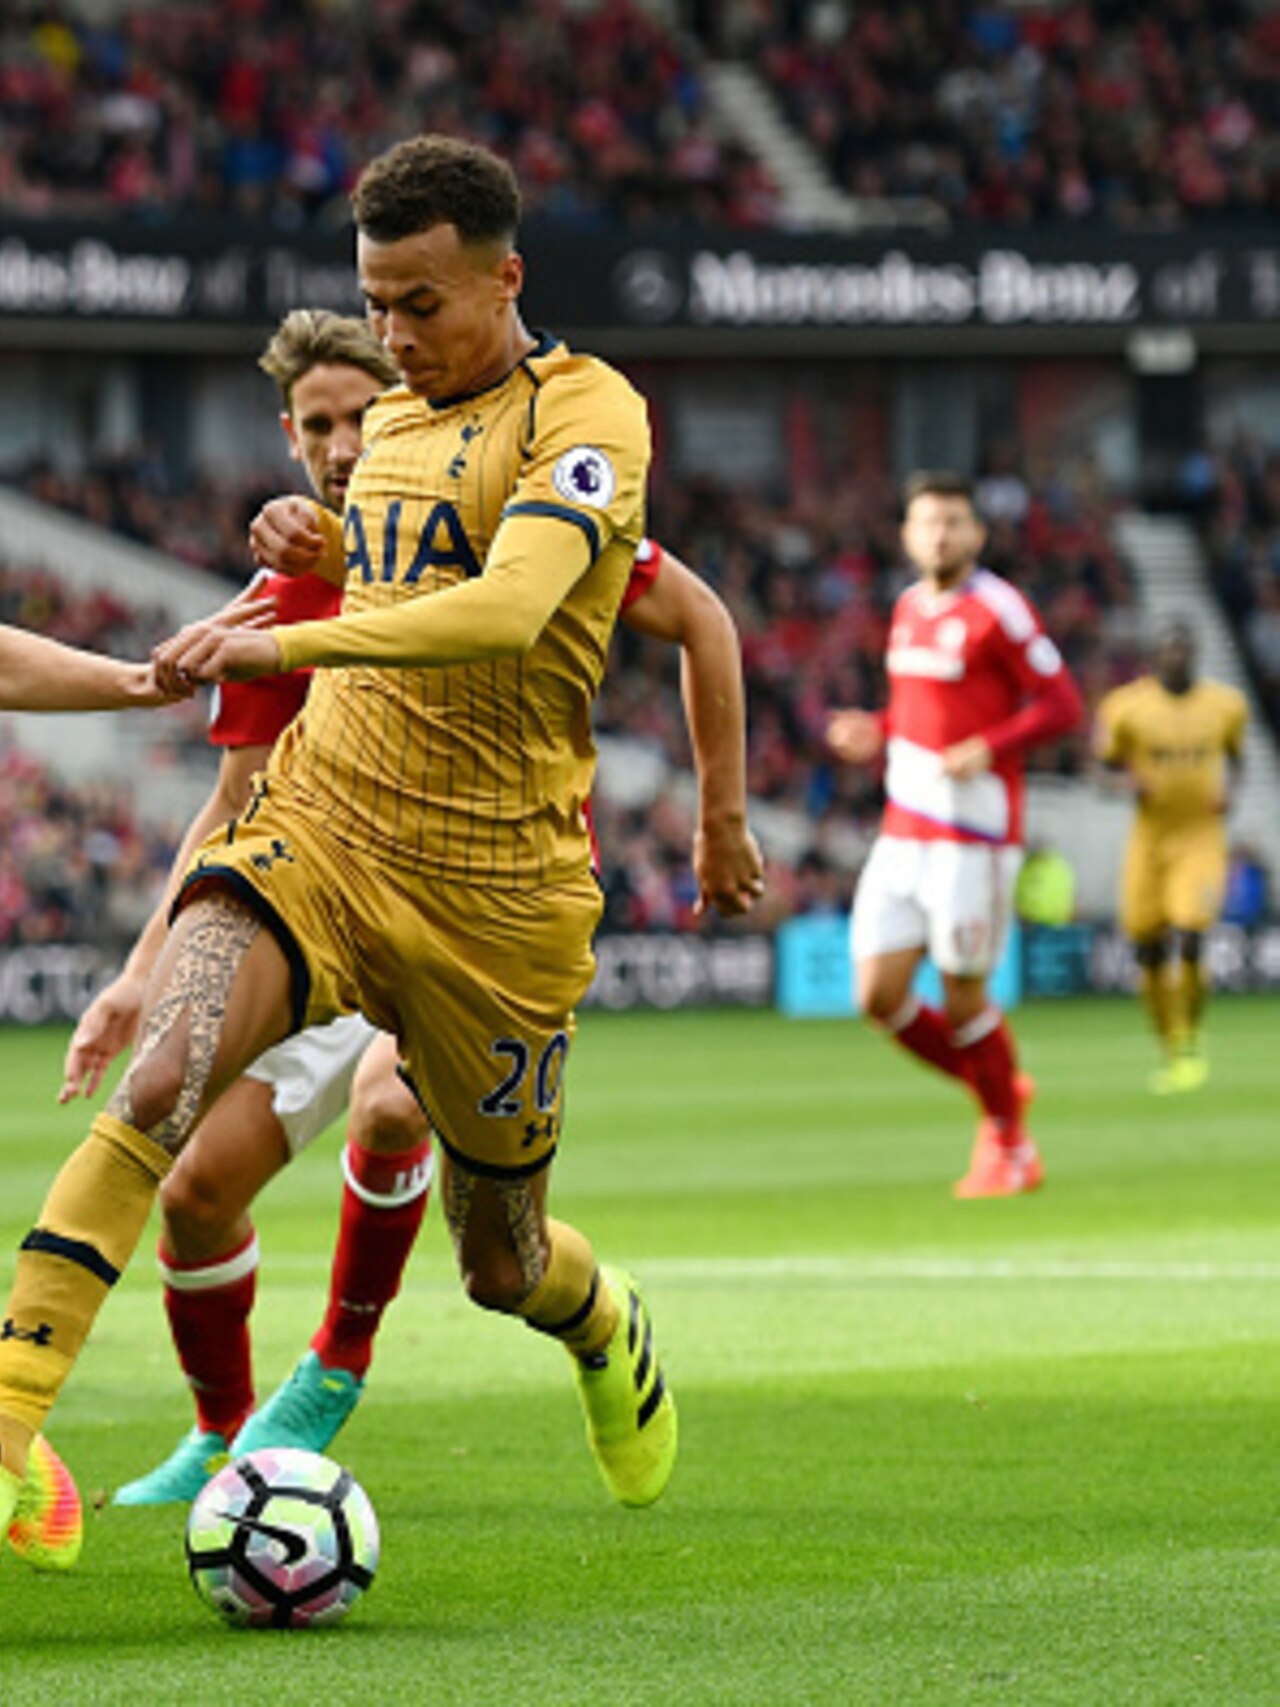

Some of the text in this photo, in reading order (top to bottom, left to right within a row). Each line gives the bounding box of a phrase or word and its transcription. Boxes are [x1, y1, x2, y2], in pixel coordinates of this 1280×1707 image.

[690, 250, 1139, 324] Mercedes-Benz
[344, 500, 484, 584] AIA
[478, 1030, 569, 1118] 20
